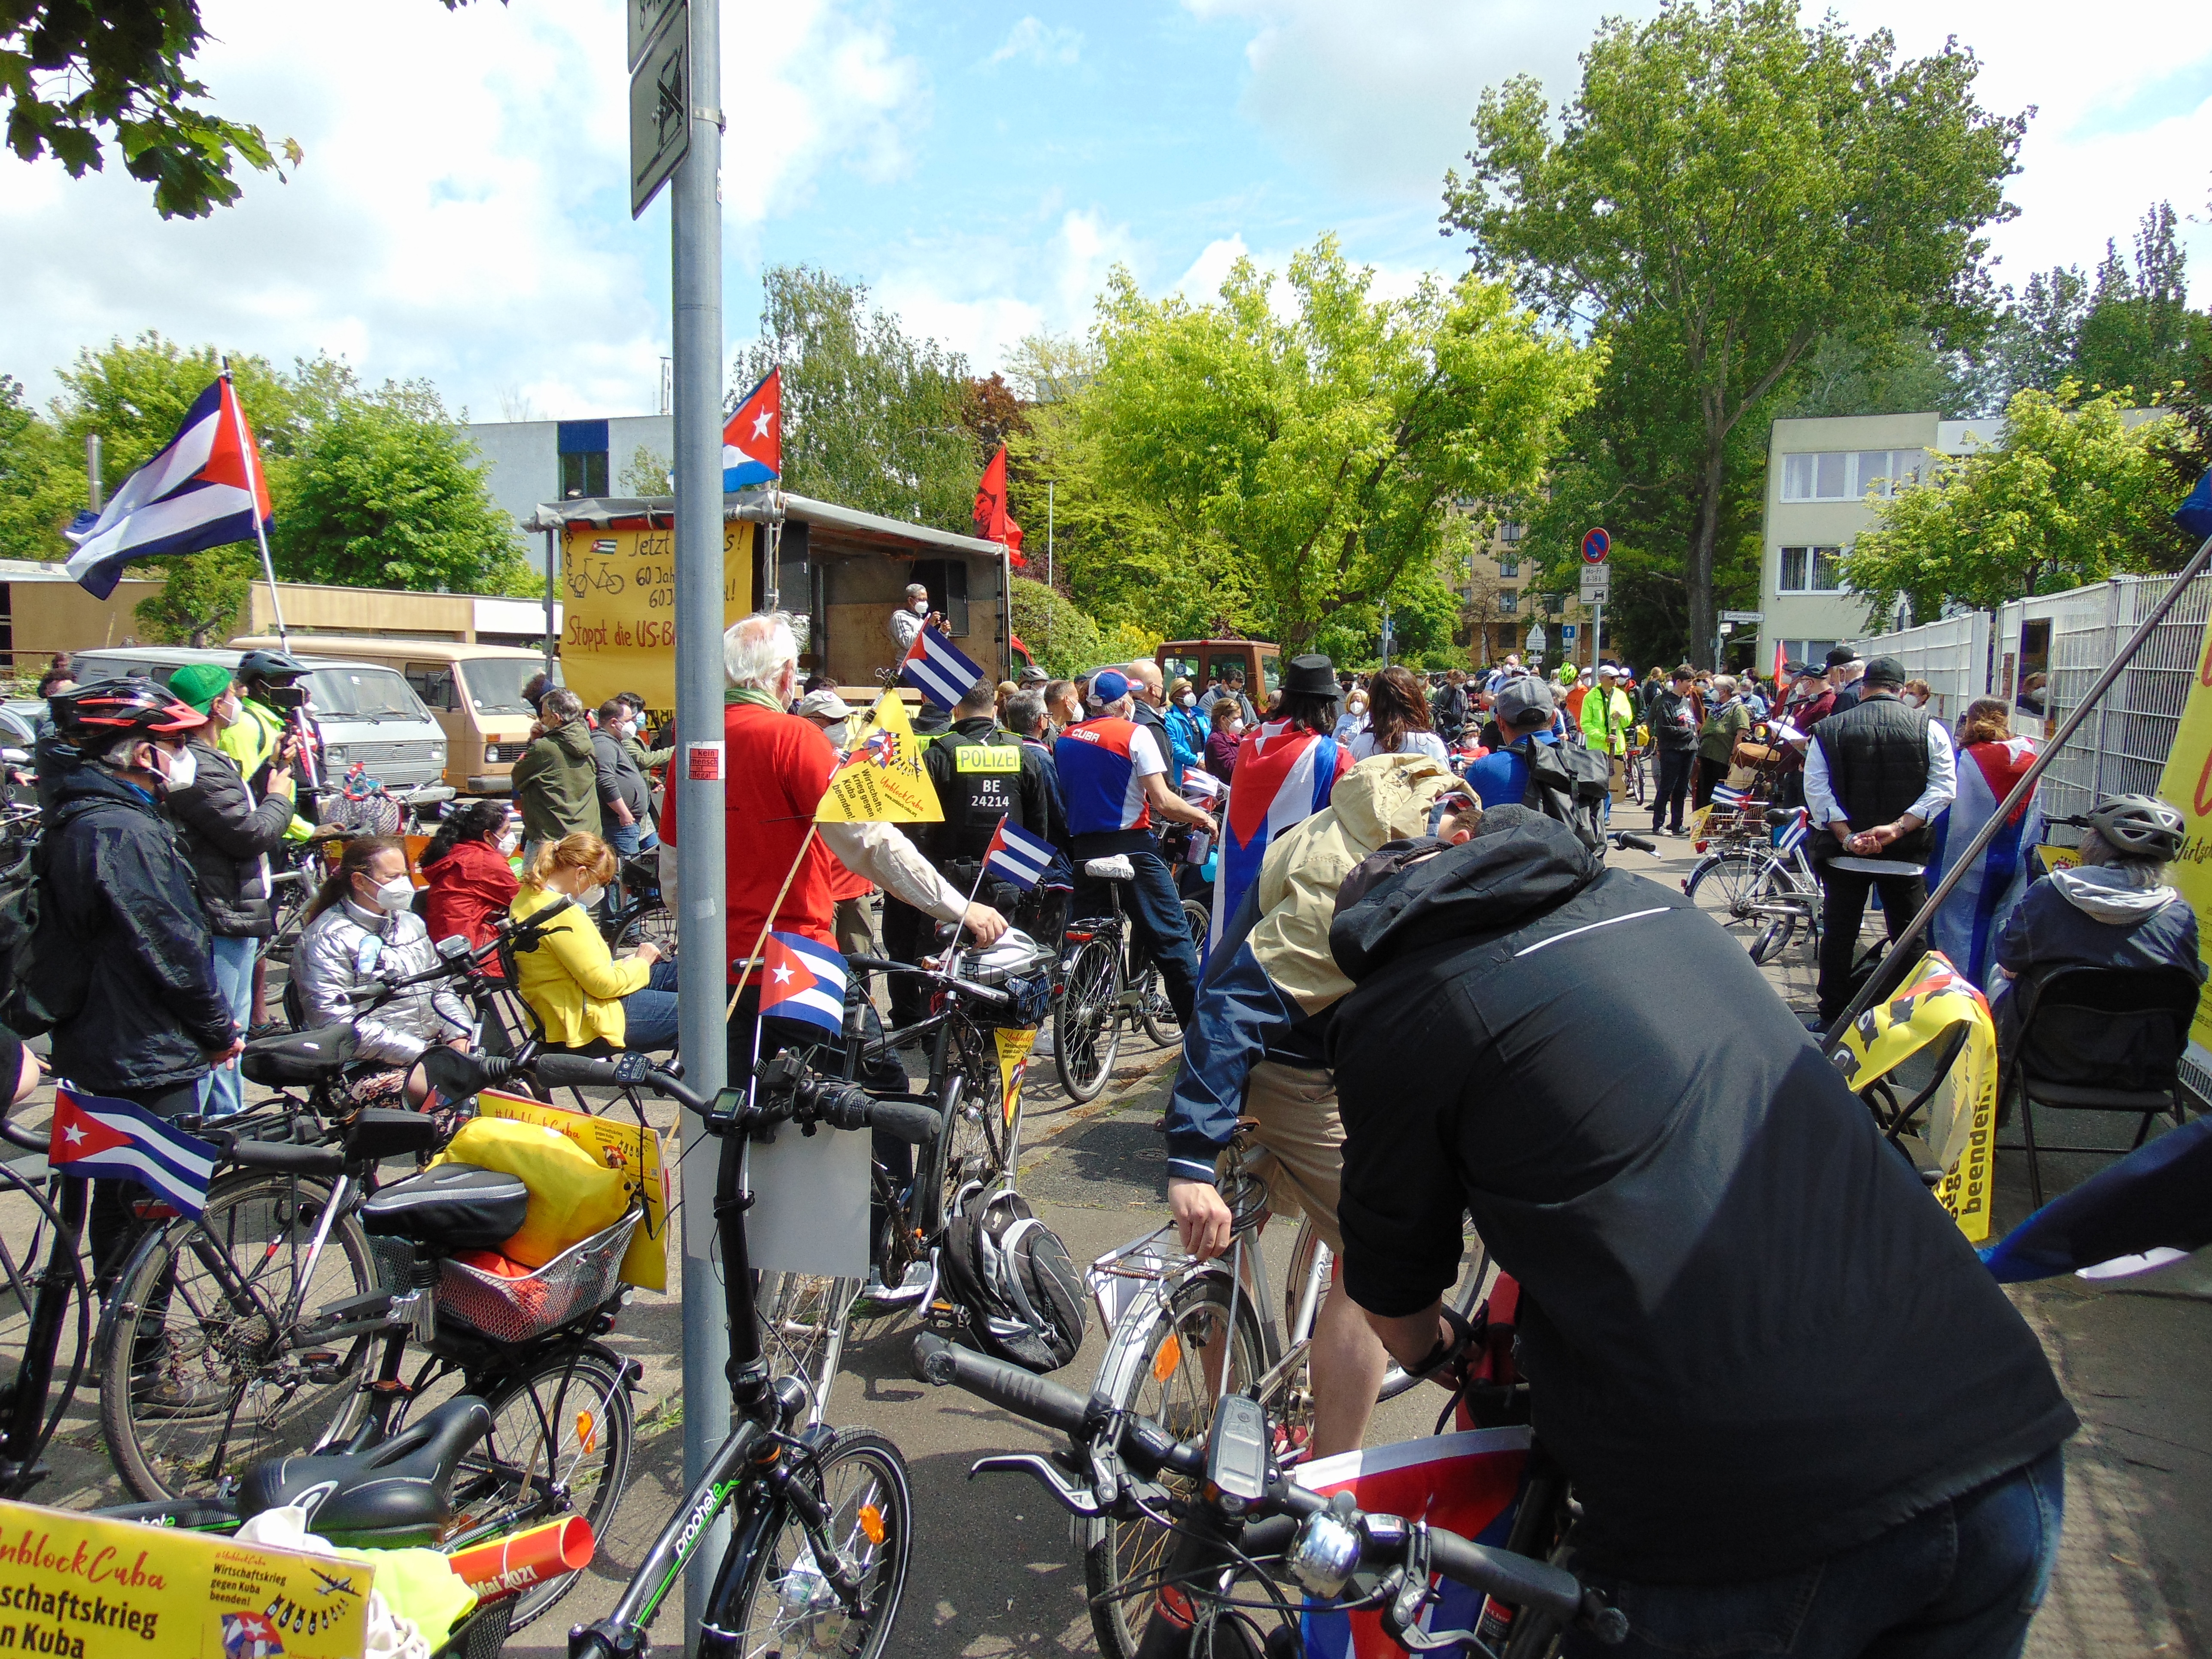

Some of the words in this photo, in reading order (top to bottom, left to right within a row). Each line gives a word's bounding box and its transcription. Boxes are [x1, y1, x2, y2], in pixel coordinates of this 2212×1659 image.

[628, 531, 670, 557] Jetzt
[636, 565, 652, 586] 60
[656, 566, 675, 584] Jah
[649, 589, 665, 608] 60
[567, 615, 608, 652] Stoppt
[614, 621, 632, 647] die
[1071, 728, 1100, 743] CUBA
[960, 750, 1017, 768] POLIZEI
[842, 778, 857, 799] Kuba
[851, 774, 865, 794] Krieg
[860, 794, 875, 818] gegen
[861, 768, 883, 814] Wirtschafts-
[880, 776, 924, 812] UnblockCuba
[983, 780, 1000, 793] BE
[832, 784, 856, 820] beenden!
[971, 796, 1009, 807] 24214
[1962, 1084, 1992, 1215] beenden
[676, 1483, 722, 1559] prophete
[0, 1527, 167, 1590] nblockCuba
[210, 1578, 240, 1590] gegen
[238, 1582, 261, 1595] Kuba
[214, 1563, 287, 1586] Wirtschaftskrieg
[471, 1576, 502, 1597] Mai
[498, 1565, 538, 1589] 2021
[210, 1590, 250, 1606] beenden!
[21, 1622, 85, 1659] Kuba
